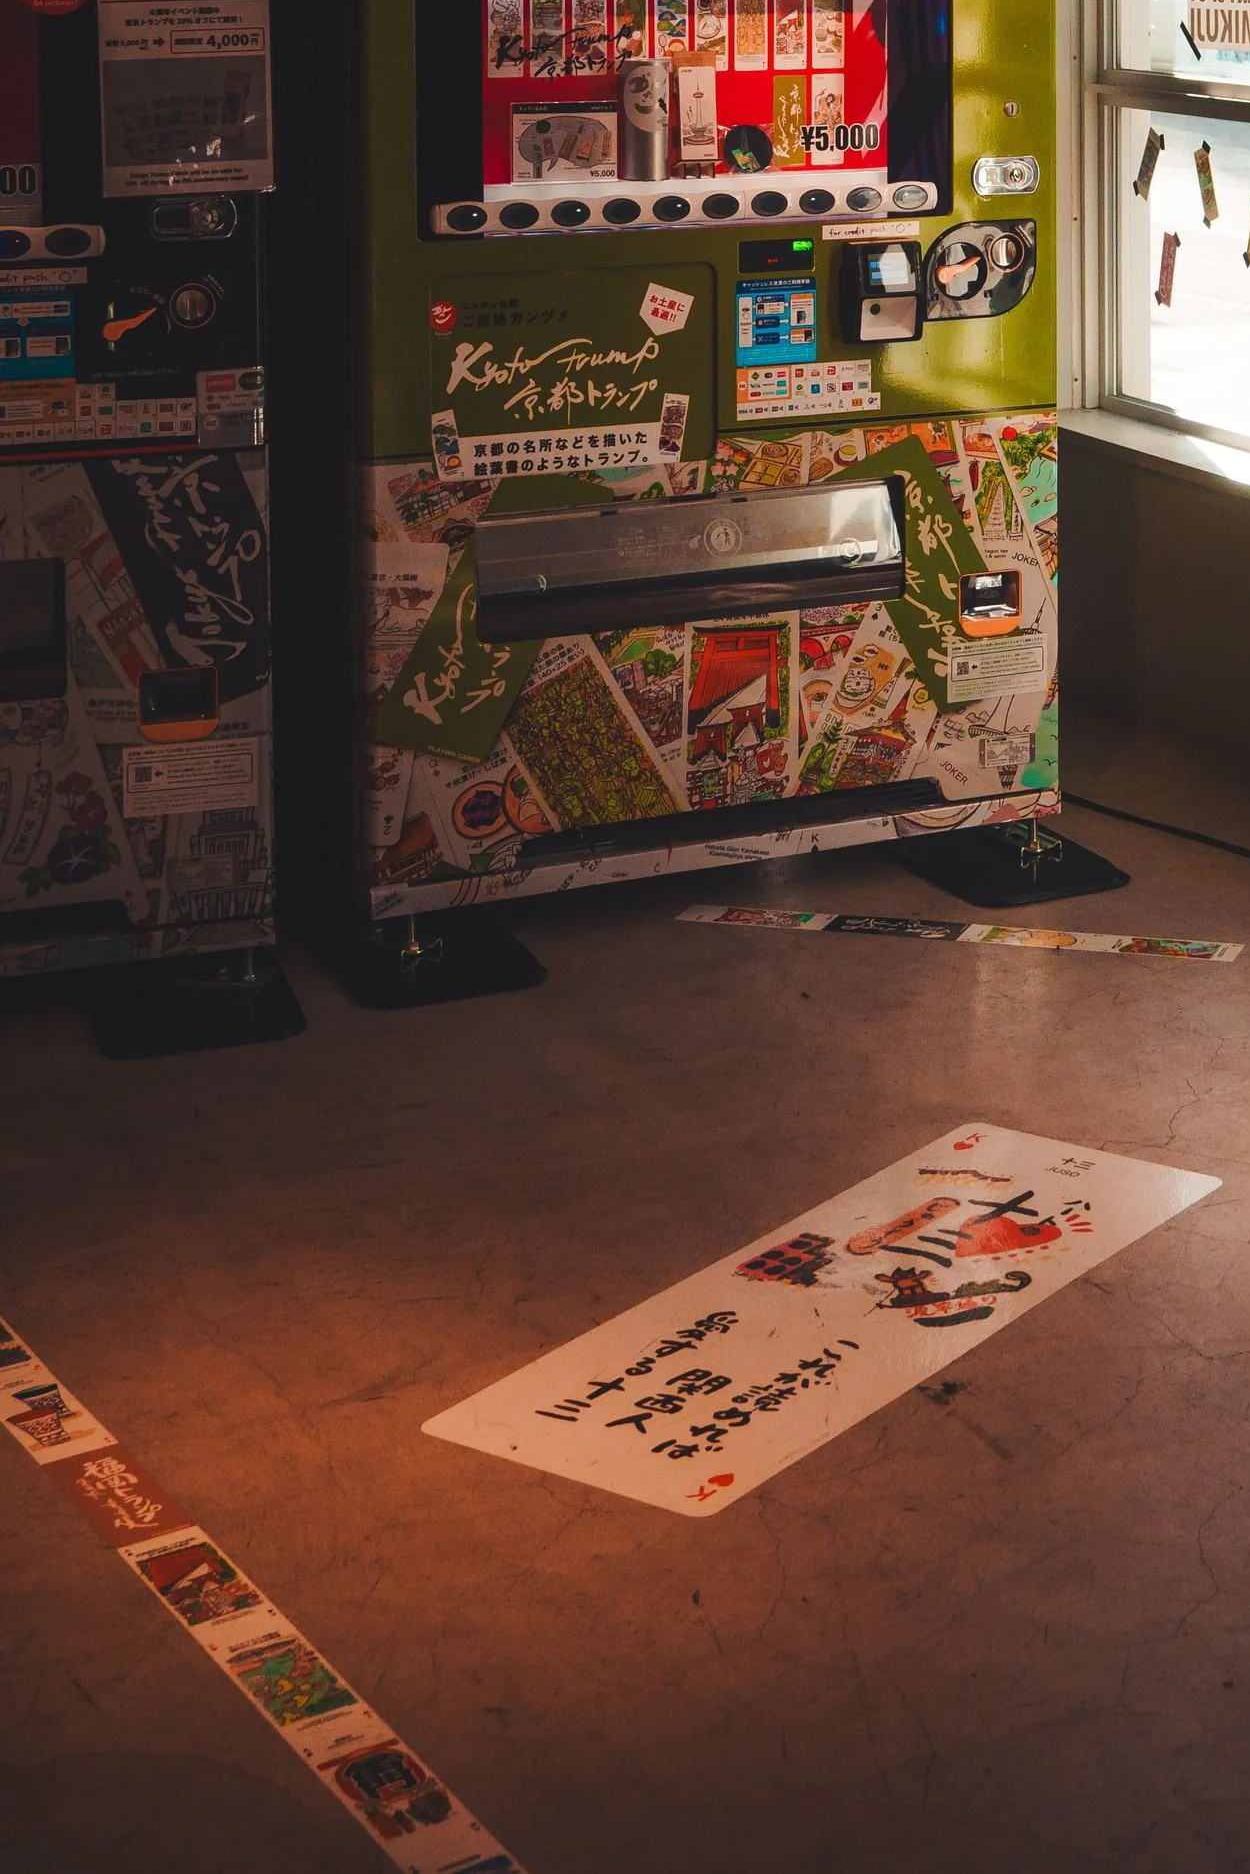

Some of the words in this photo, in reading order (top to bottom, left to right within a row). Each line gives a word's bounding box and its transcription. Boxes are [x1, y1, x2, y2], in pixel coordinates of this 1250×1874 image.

[801, 123, 880, 152] ¥5,000
[590, 169, 616, 178] ¥5,000
[828, 229, 842, 238] for
[843, 227, 865, 236] credit
[870, 225, 888, 235] push
[23, 272, 50, 284] push
[649, 294, 686, 312] お土産に
[446, 340, 548, 395] Kyoto
[503, 377, 659, 426] 京都トランプ
[474, 432, 648, 458] 京都の名所などを描いた
[474, 451, 651, 477] 絵葉書のようなトランプ。
[875, 603, 883, 612] 3
[428, 759, 439, 769] Q
[939, 760, 969, 786] JOKER
[811, 833, 819, 843] K
[705, 843, 725, 852] Hakata
[726, 845, 740, 853] Gion
[740, 847, 770, 856] Yamakasa
[1061, 1157, 1096, 1171] 十三
[1045, 1165, 1081, 1177] JUSO
